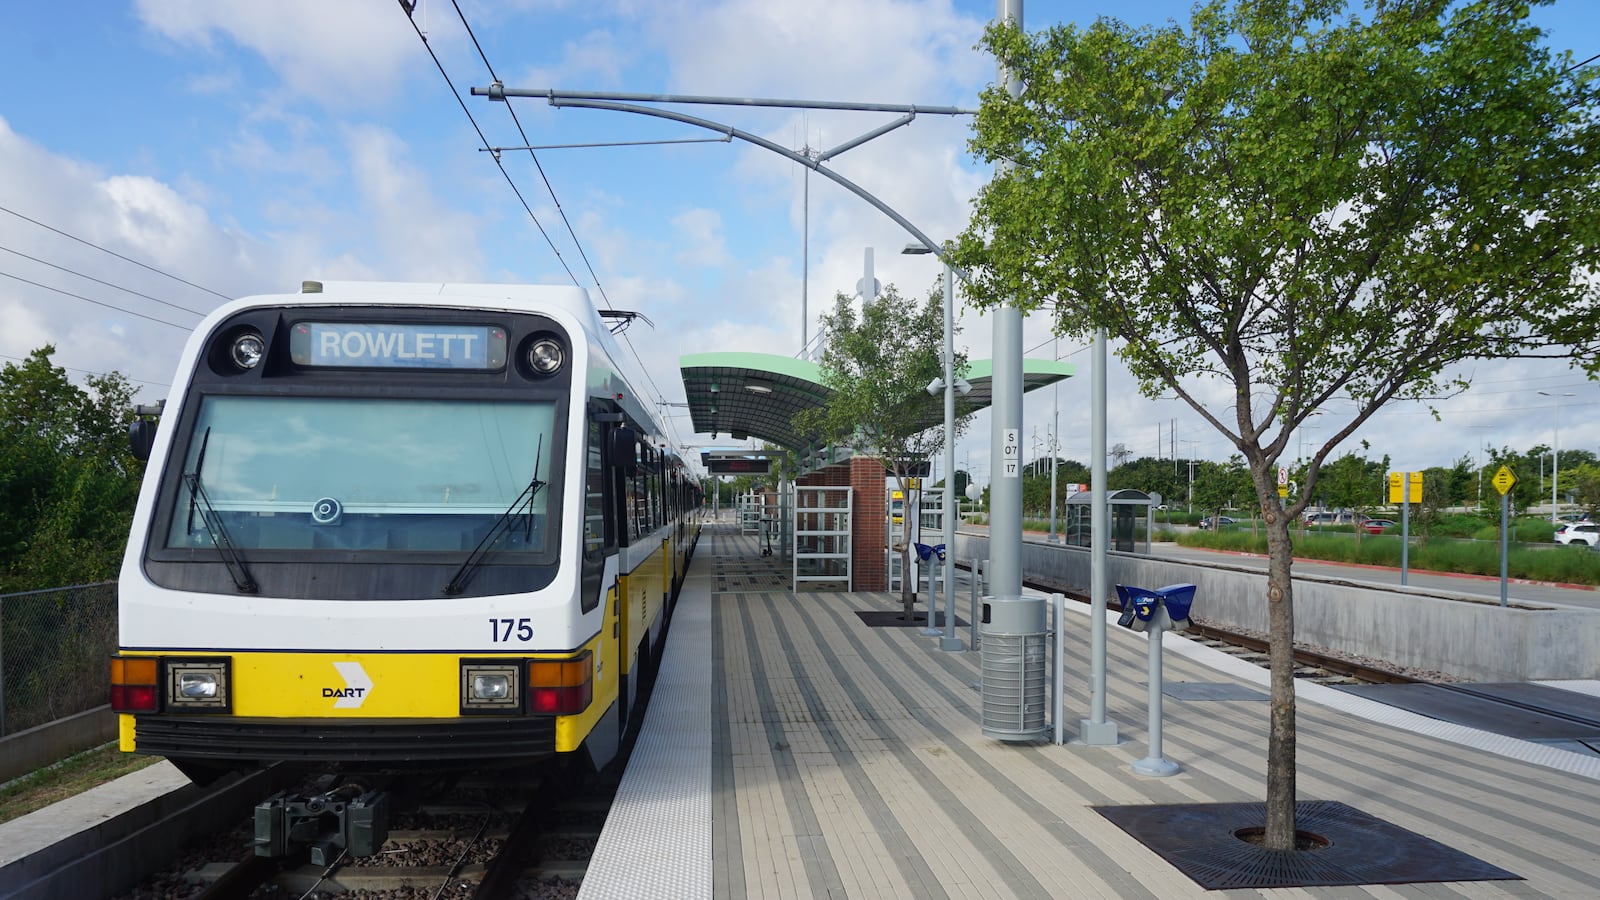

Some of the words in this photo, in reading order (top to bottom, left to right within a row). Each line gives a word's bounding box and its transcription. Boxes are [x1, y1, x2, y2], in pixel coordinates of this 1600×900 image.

[320, 331, 478, 359] ROWLETT
[1008, 433, 1015, 442] S
[1005, 446, 1017, 455] 07
[1006, 464, 1016, 473] 17
[489, 618, 534, 642] 175
[322, 687, 365, 698] DART
